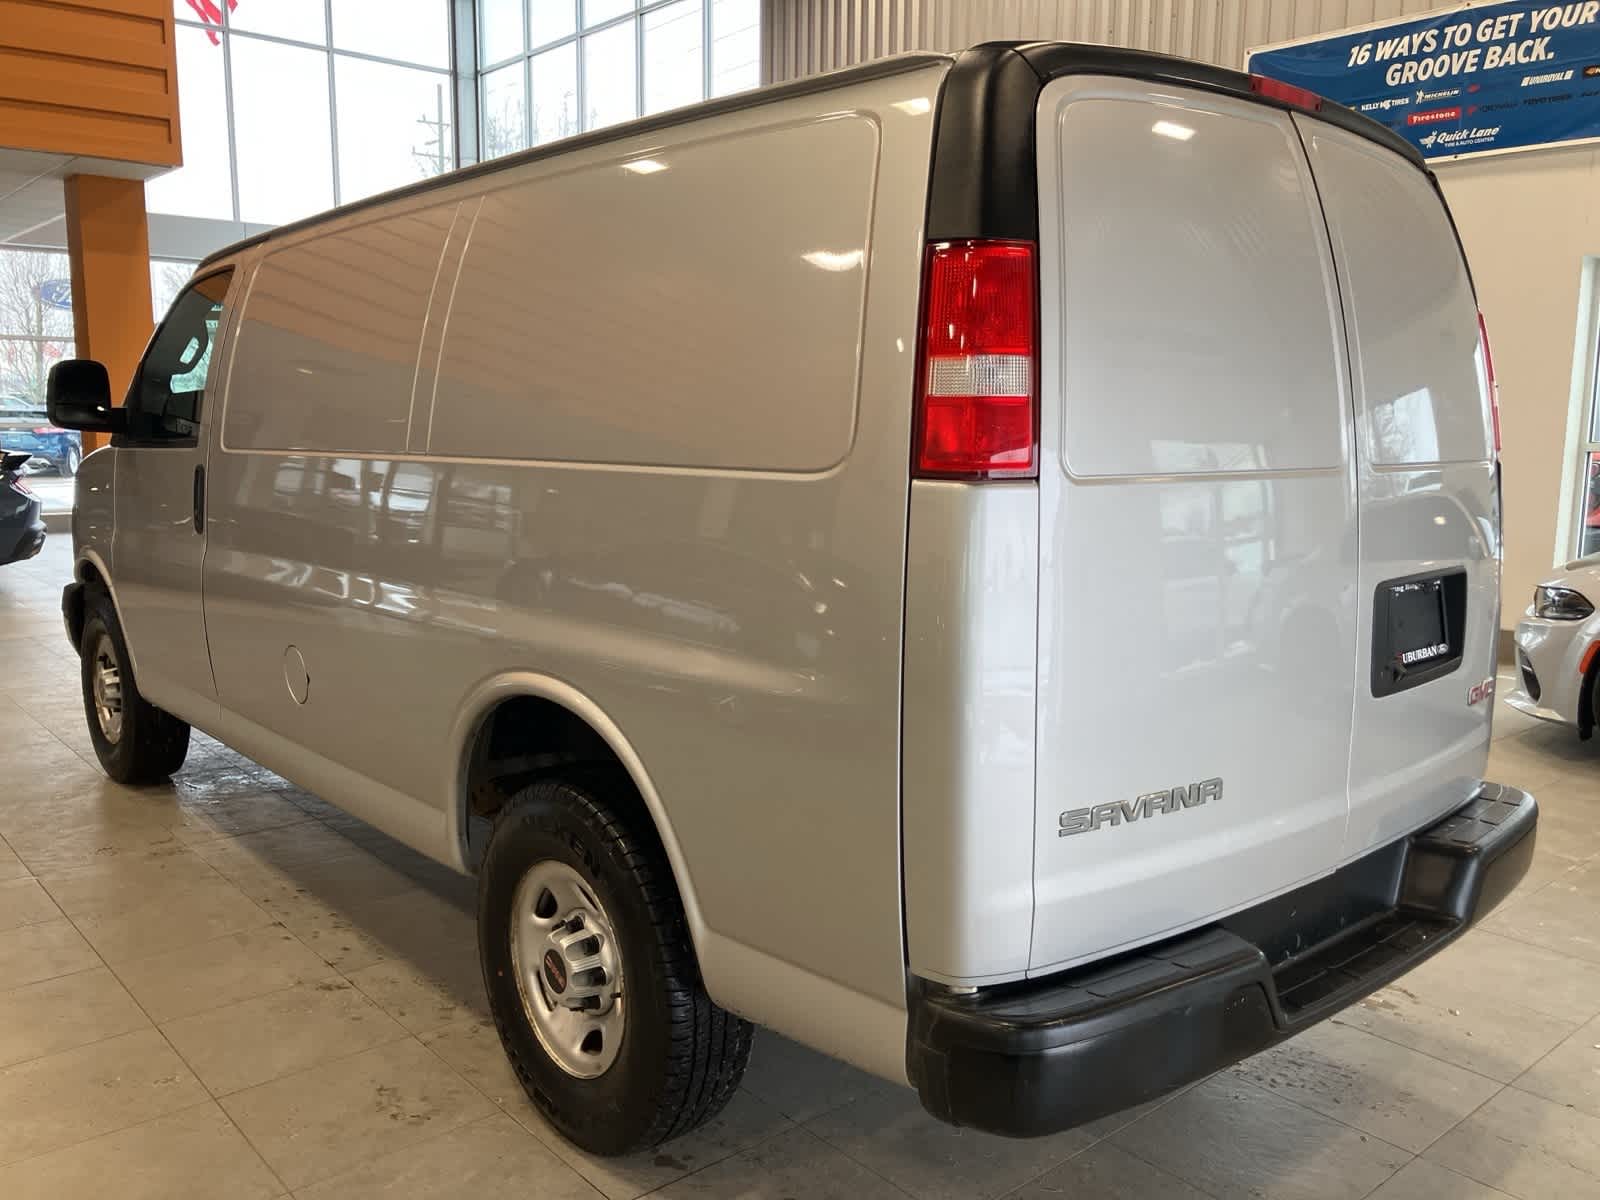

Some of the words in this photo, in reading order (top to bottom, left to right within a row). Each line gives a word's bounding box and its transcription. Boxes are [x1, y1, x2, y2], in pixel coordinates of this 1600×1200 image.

[1347, 43, 1373, 68] 16
[1374, 29, 1440, 62] WAYS
[1443, 22, 1473, 50] TO
[1476, 12, 1525, 43] GET
[1529, 0, 1600, 34] YOUR
[1385, 48, 1482, 87] GROOVE
[1483, 35, 1555, 70] BACK.
[1412, 110, 1456, 123] Firestone
[1437, 129, 1469, 144] Quick
[1469, 127, 1500, 138] Lane
[1058, 777, 1223, 838] SAVANA
